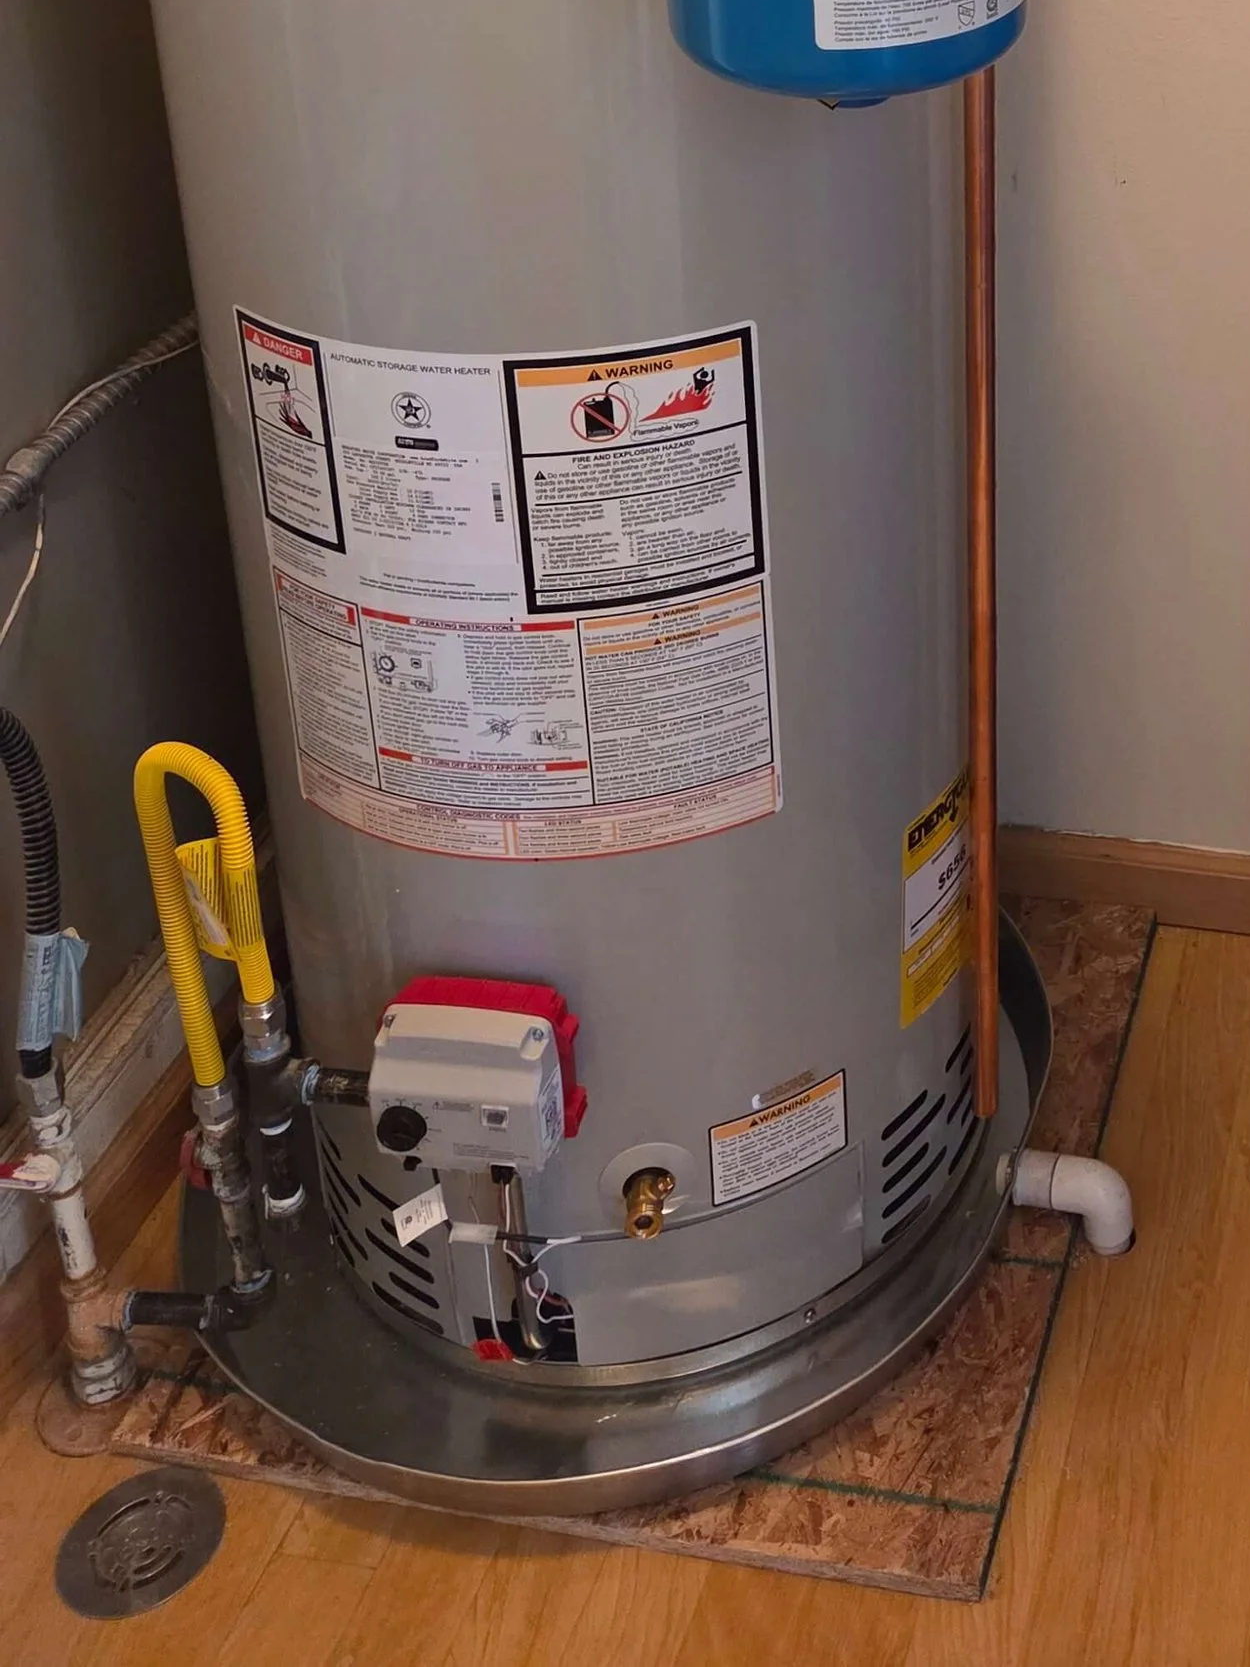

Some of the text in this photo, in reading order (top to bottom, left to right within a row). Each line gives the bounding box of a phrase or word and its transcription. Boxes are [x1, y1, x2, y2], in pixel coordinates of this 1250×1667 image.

[263, 336, 304, 360] DANGER
[330, 353, 491, 375] AUTOMATIC STORAGE WATER HEATER
[605, 359, 674, 378] WARNING
[633, 424, 673, 437] Flammable
[572, 439, 696, 464] FIRE AND EXPLOSION HAZARD
[612, 464, 639, 473] gasoline
[667, 453, 700, 463] flammable
[702, 447, 722, 456] vapors
[724, 442, 735, 451] and
[621, 456, 644, 464] serious
[646, 453, 664, 461] injury
[557, 484, 585, 493] gasoline
[613, 477, 647, 486] flammable
[648, 473, 671, 481] vapors
[680, 467, 700, 476] liquids
[720, 456, 741, 465] vicinity
[577, 476, 599, 485] vicinity
[699, 454, 723, 464] Storage
[598, 486, 630, 495] appliance
[672, 475, 695, 484] serious
[696, 471, 713, 479] injury
[662, 604, 700, 618] WARNING
[662, 617, 678, 625] YOUR
[679, 612, 700, 622] SAFETY
[415, 619, 513, 632] OPERATING INSTRUCTIONS
[664, 629, 700, 643] WARNING
[757, 1094, 811, 1124] WARNING
